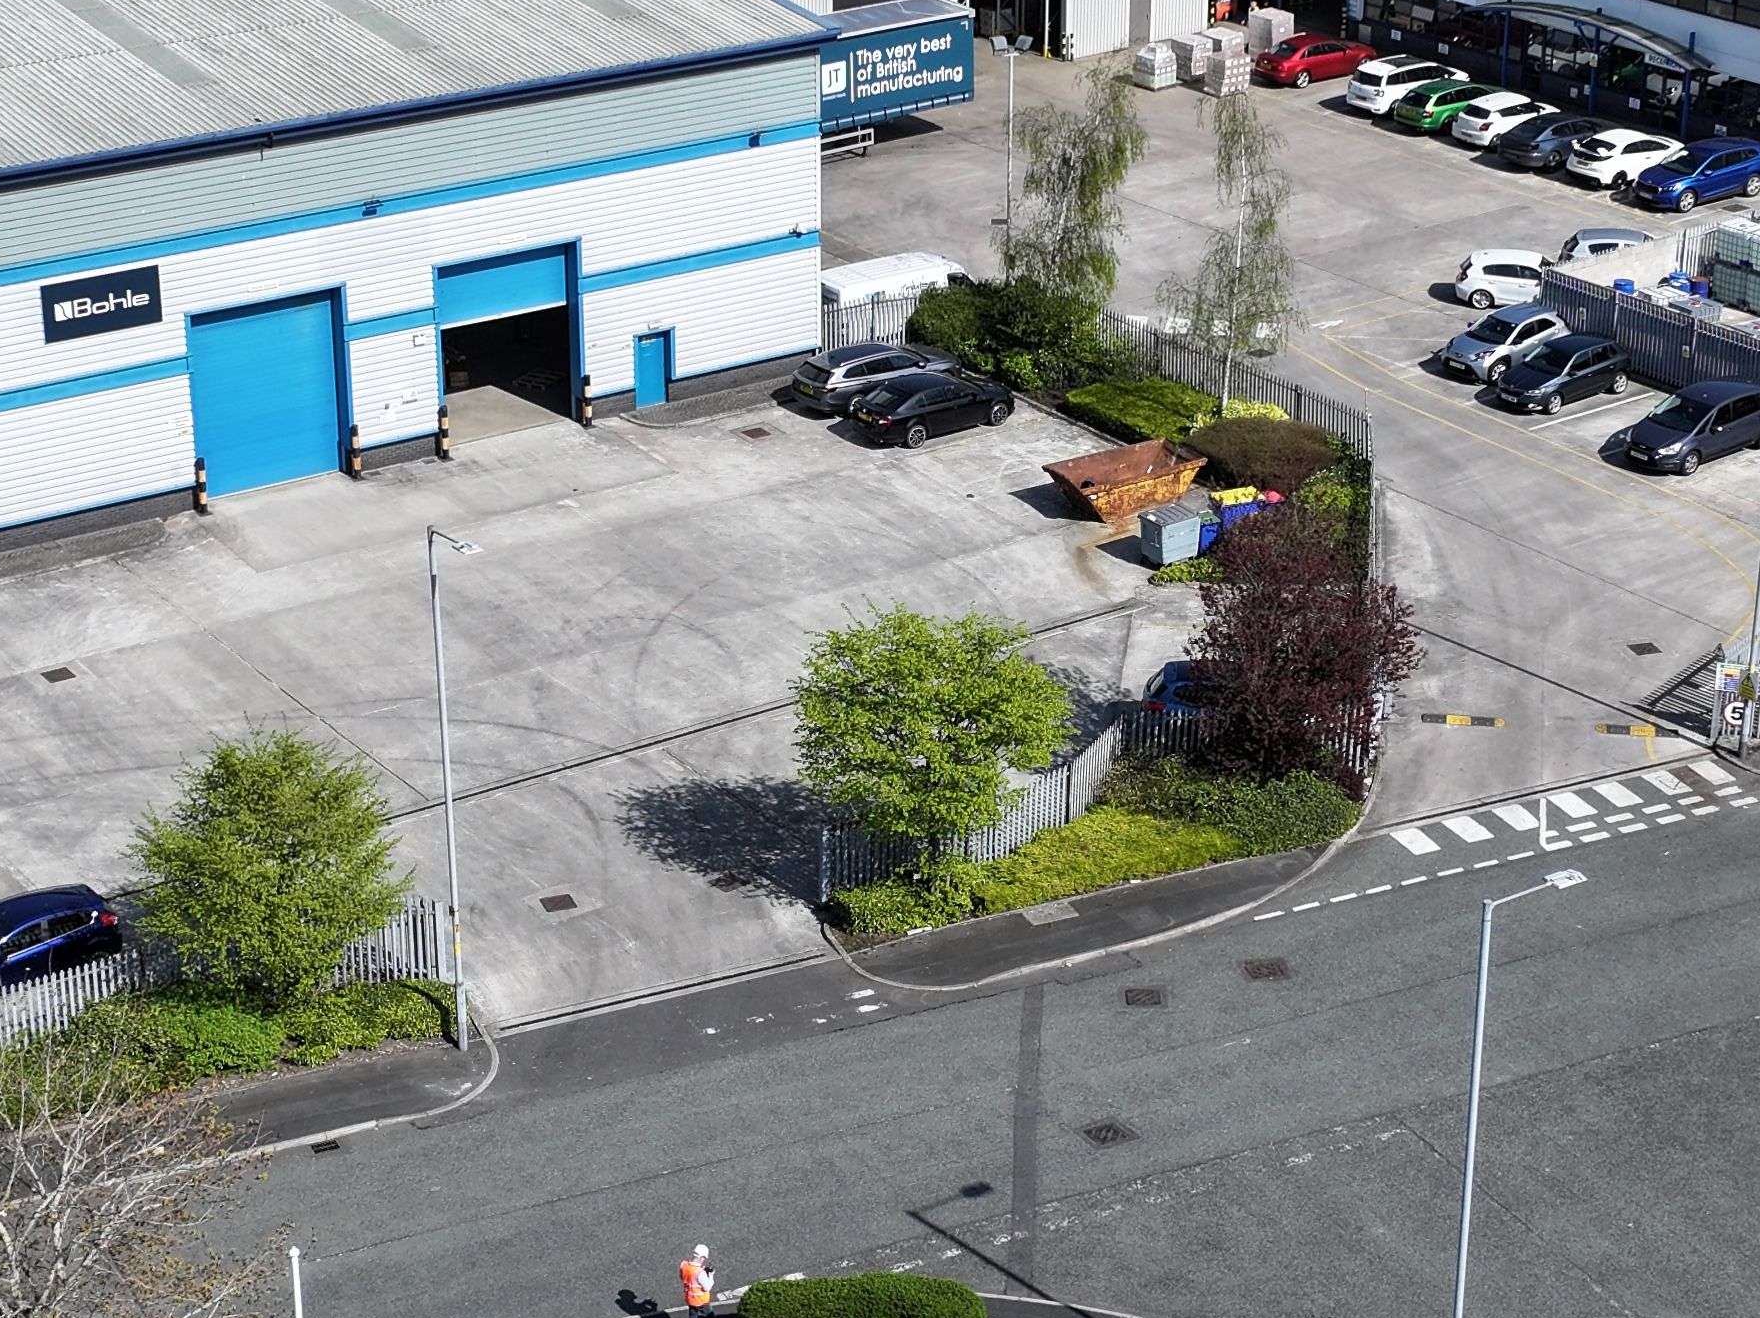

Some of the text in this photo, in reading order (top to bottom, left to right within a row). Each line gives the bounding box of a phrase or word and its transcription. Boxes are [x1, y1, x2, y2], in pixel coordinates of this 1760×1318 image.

[856, 33, 952, 66] The very best
[827, 69, 841, 87] JT
[857, 57, 916, 81] of British
[857, 65, 963, 98] manufacturing
[73, 289, 150, 318] Bohle
[1730, 706, 1744, 720] 5
